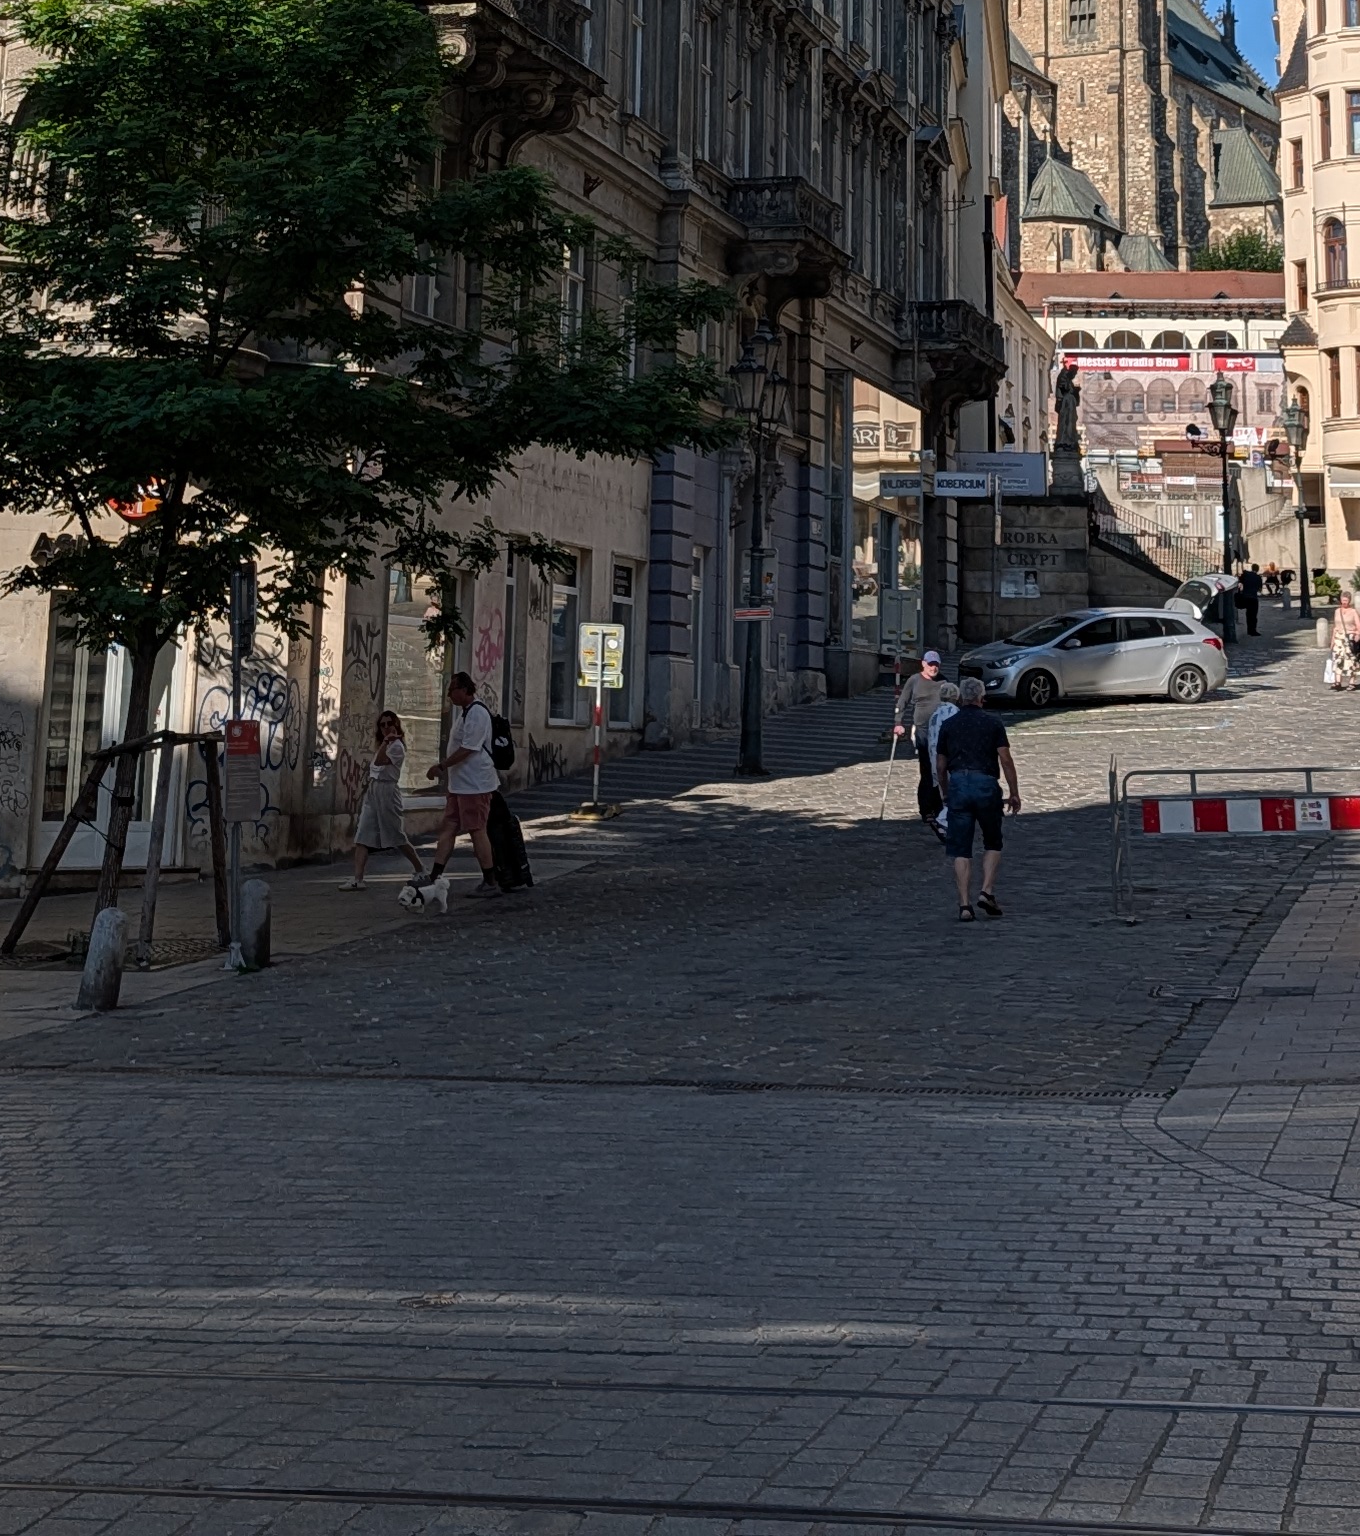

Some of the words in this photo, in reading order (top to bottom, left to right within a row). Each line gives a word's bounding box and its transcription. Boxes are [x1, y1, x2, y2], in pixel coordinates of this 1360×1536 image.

[1119, 356, 1155, 368] divadlo
[1155, 357, 1179, 368] Brno
[1003, 532, 1059, 545] ROBKA
[1007, 553, 1060, 566] CRYPT
